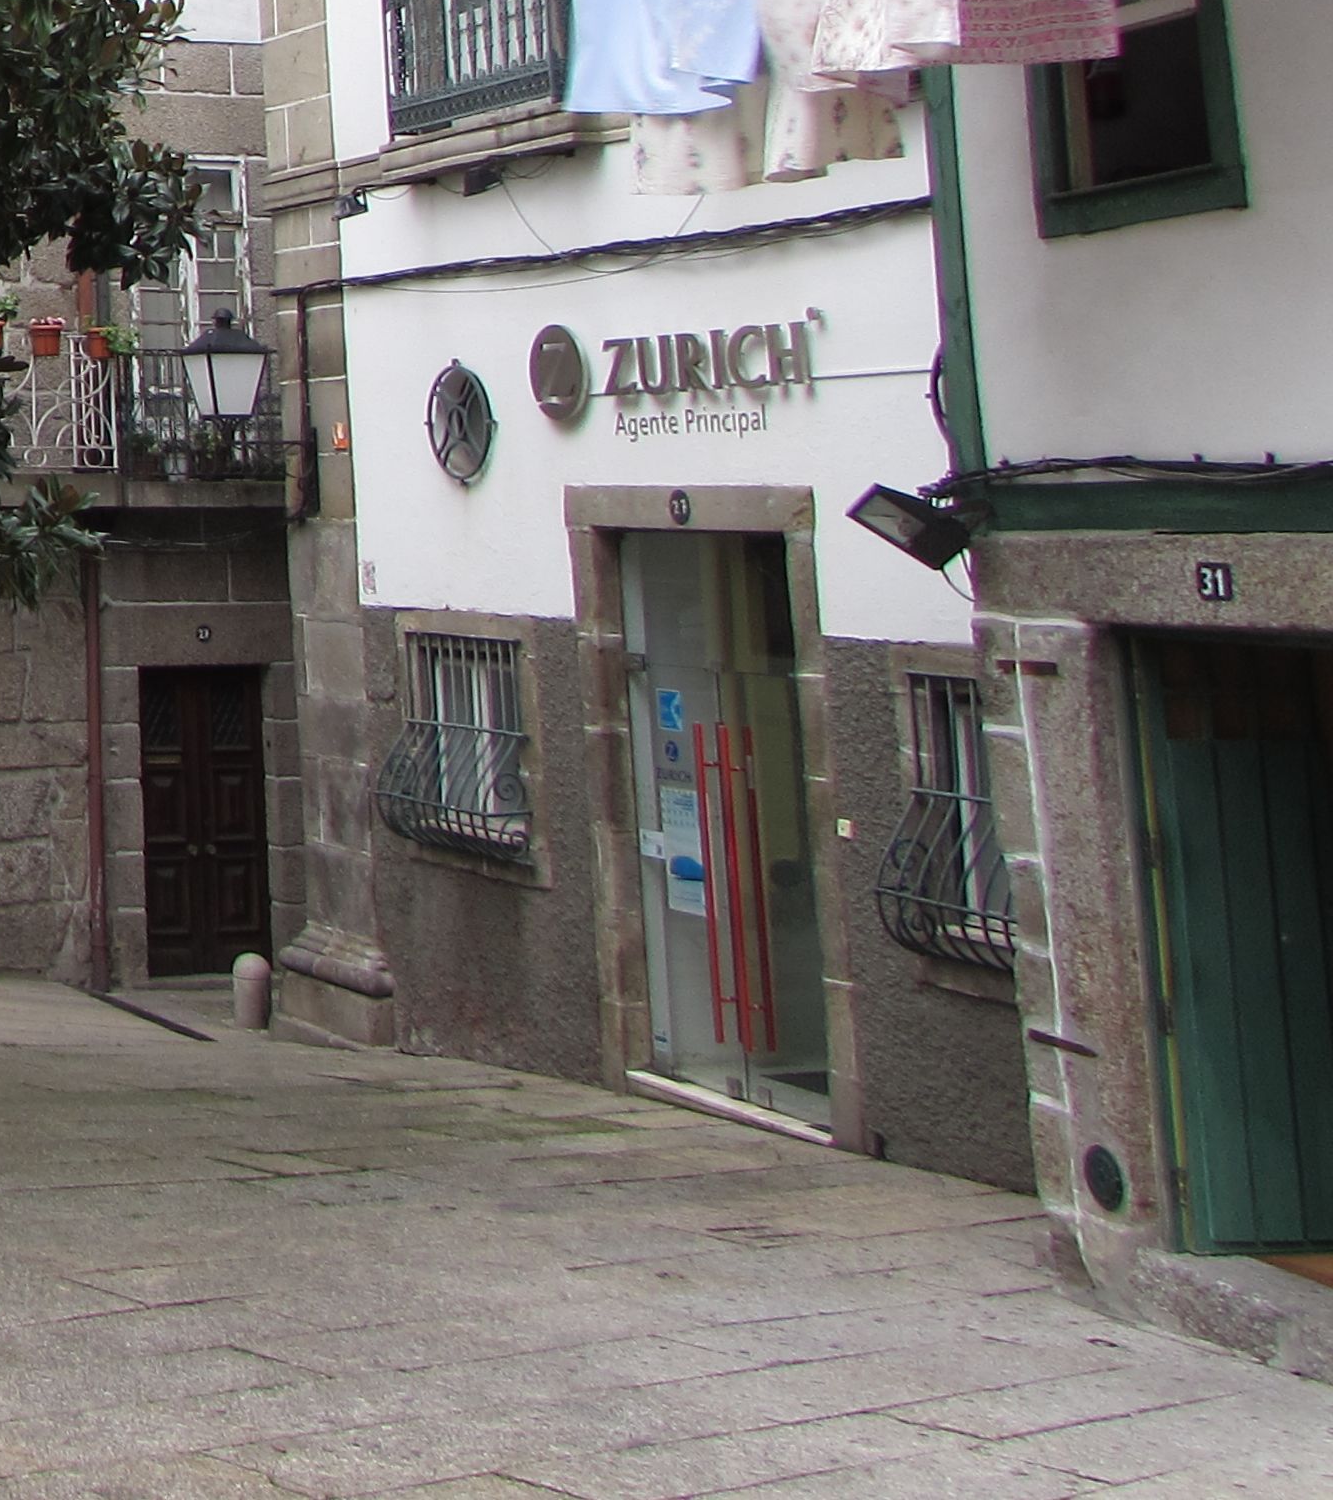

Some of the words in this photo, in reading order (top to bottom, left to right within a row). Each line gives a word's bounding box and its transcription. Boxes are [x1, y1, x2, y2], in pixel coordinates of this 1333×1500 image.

[600, 320, 812, 396] ZURICH
[614, 411, 680, 443] Agente
[684, 404, 768, 439] Principal
[1199, 567, 1226, 597] 31
